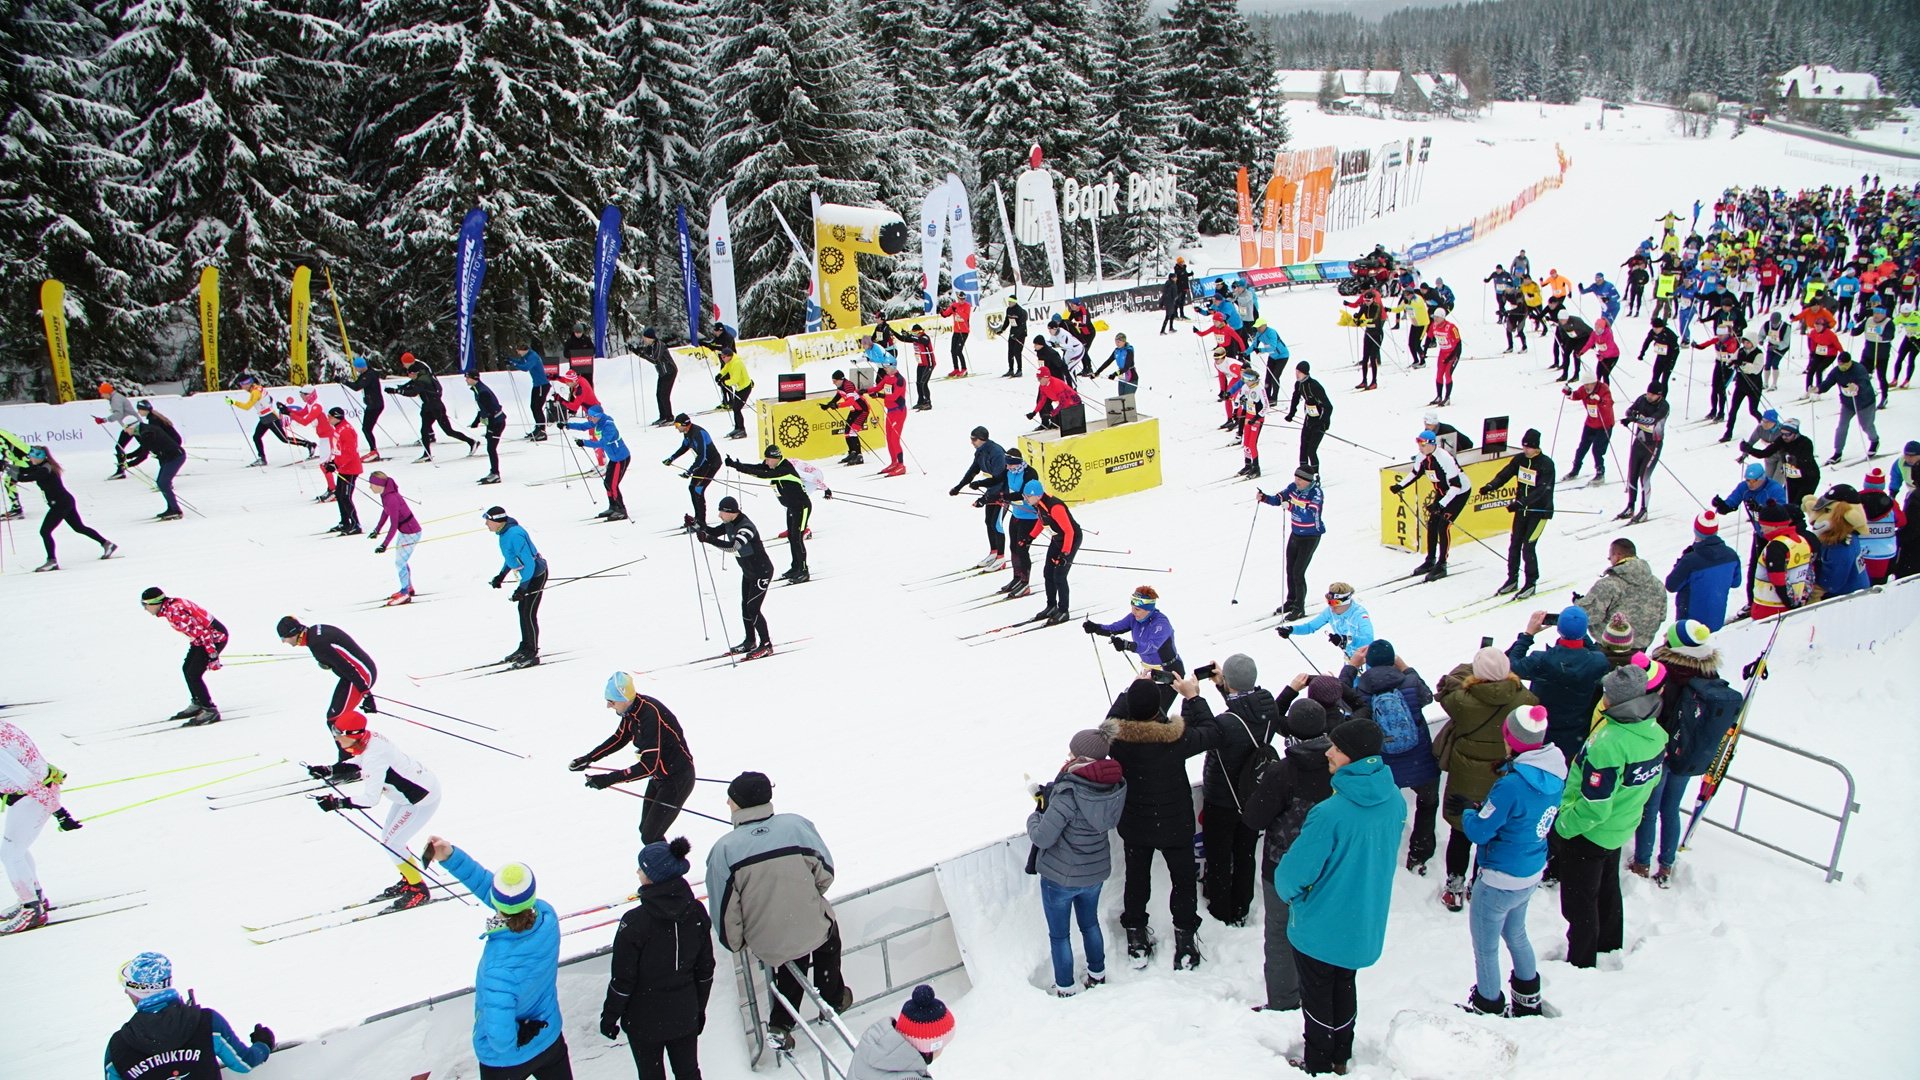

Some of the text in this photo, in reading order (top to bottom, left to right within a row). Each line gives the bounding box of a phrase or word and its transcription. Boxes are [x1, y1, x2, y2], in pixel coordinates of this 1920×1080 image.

[1063, 166, 1177, 223] Bank Polski
[1028, 306, 1050, 321] LNY
[762, 403, 770, 447] STAR
[19, 429, 83, 443] ank Polski
[1522, 472, 1531, 480] 99
[1869, 526, 1892, 535] ROLLER
[127, 1048, 201, 1079] INSTRUKTOR
